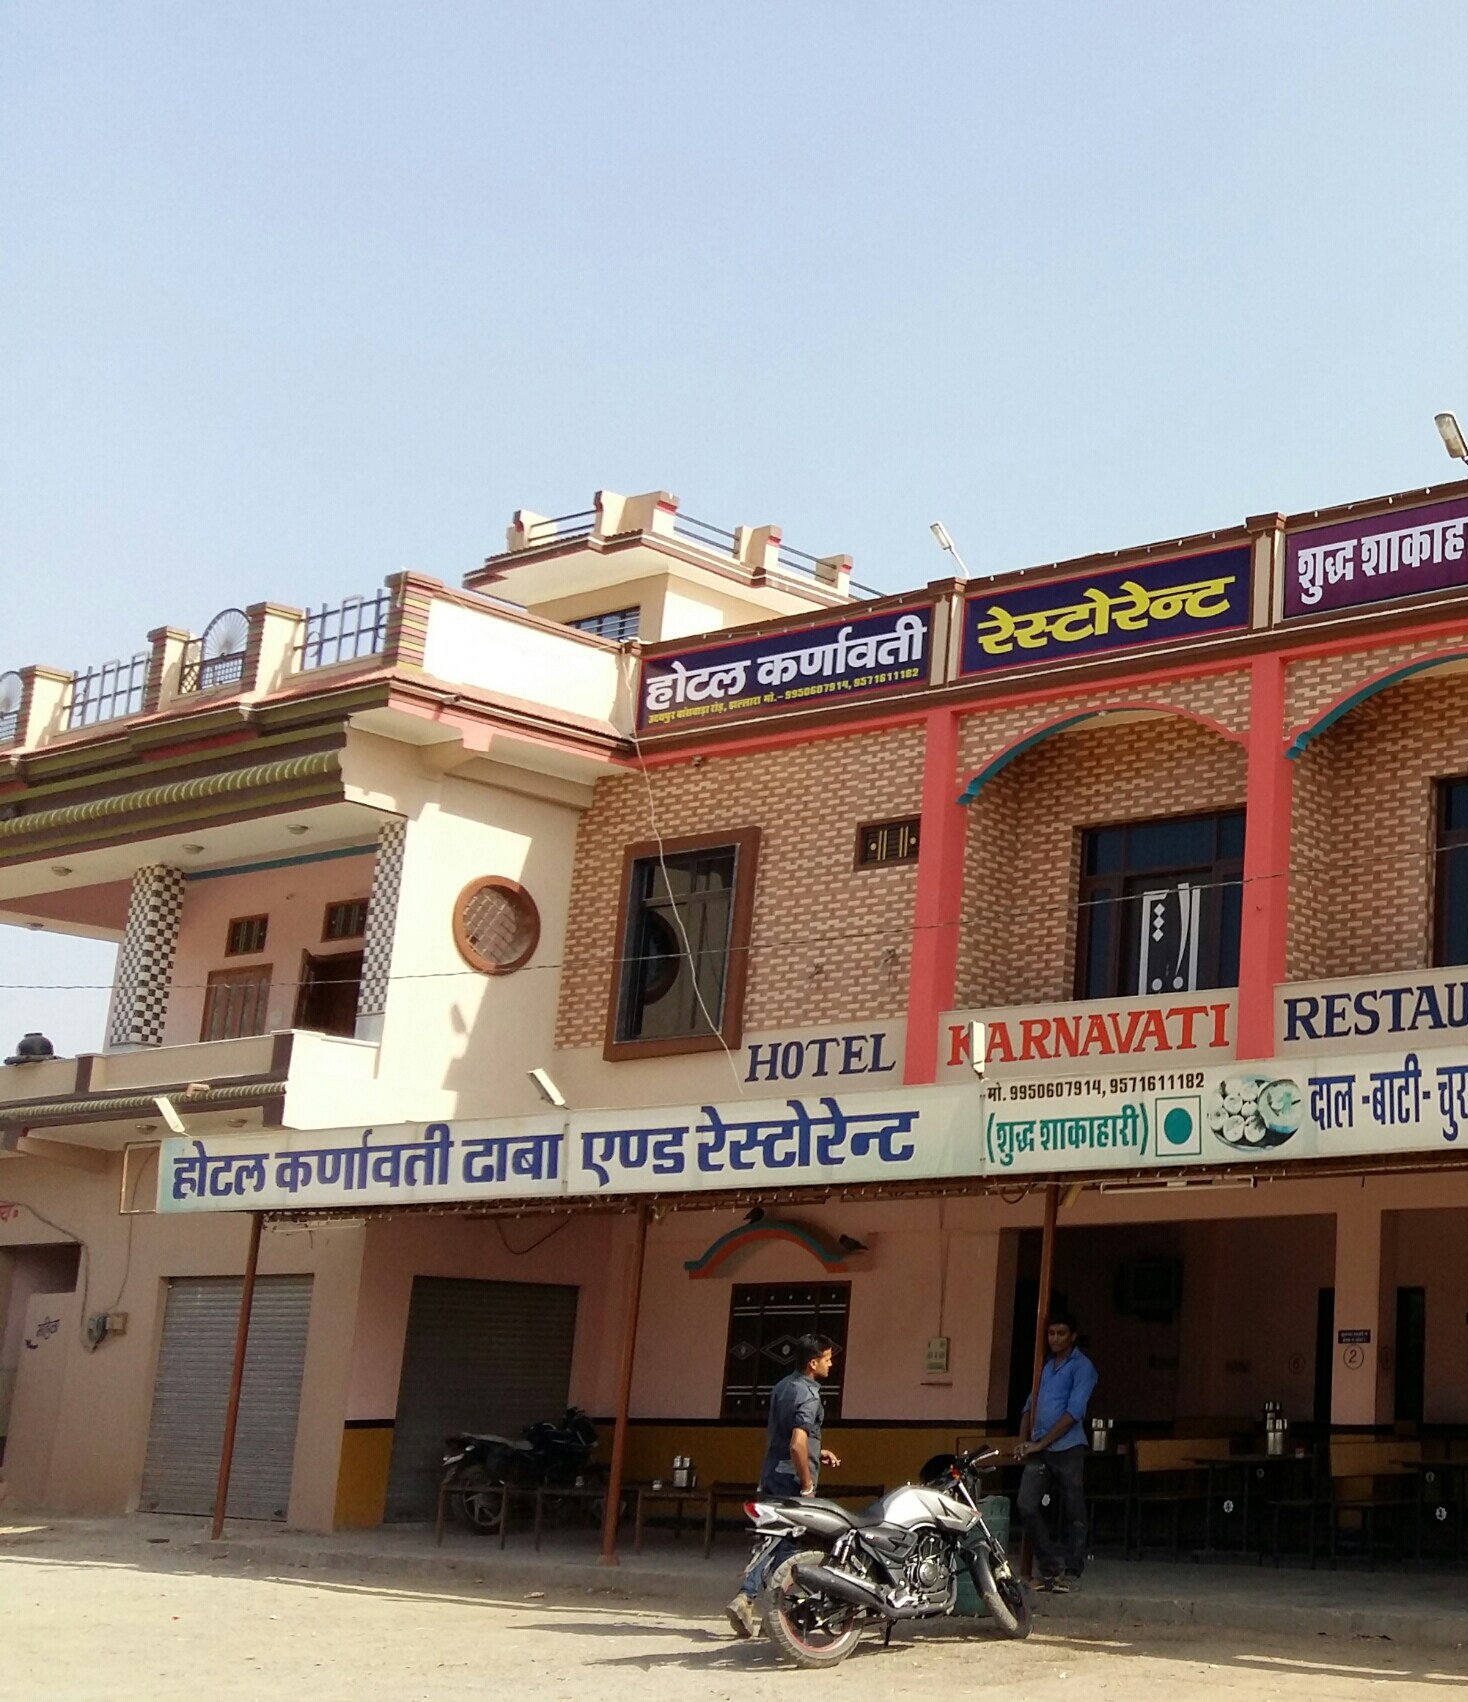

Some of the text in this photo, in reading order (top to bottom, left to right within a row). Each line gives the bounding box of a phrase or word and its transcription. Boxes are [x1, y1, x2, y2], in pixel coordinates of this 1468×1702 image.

[1298, 539, 1357, 604] शुद्ध
[977, 576, 1236, 654] रेस्टोरेन्ट
[646, 614, 927, 711] होटल कर्णावती
[744, 1033, 896, 1083] HOTEL
[947, 1003, 1231, 1066] KARNAVATI
[1109, 1072, 1205, 1094] 9571611182
[172, 1141, 270, 1199] होटल
[275, 1123, 454, 1193] कर्णावती
[581, 1126, 689, 1187] एण्ड
[695, 1097, 920, 1171] रेस्टोरेन्ट
